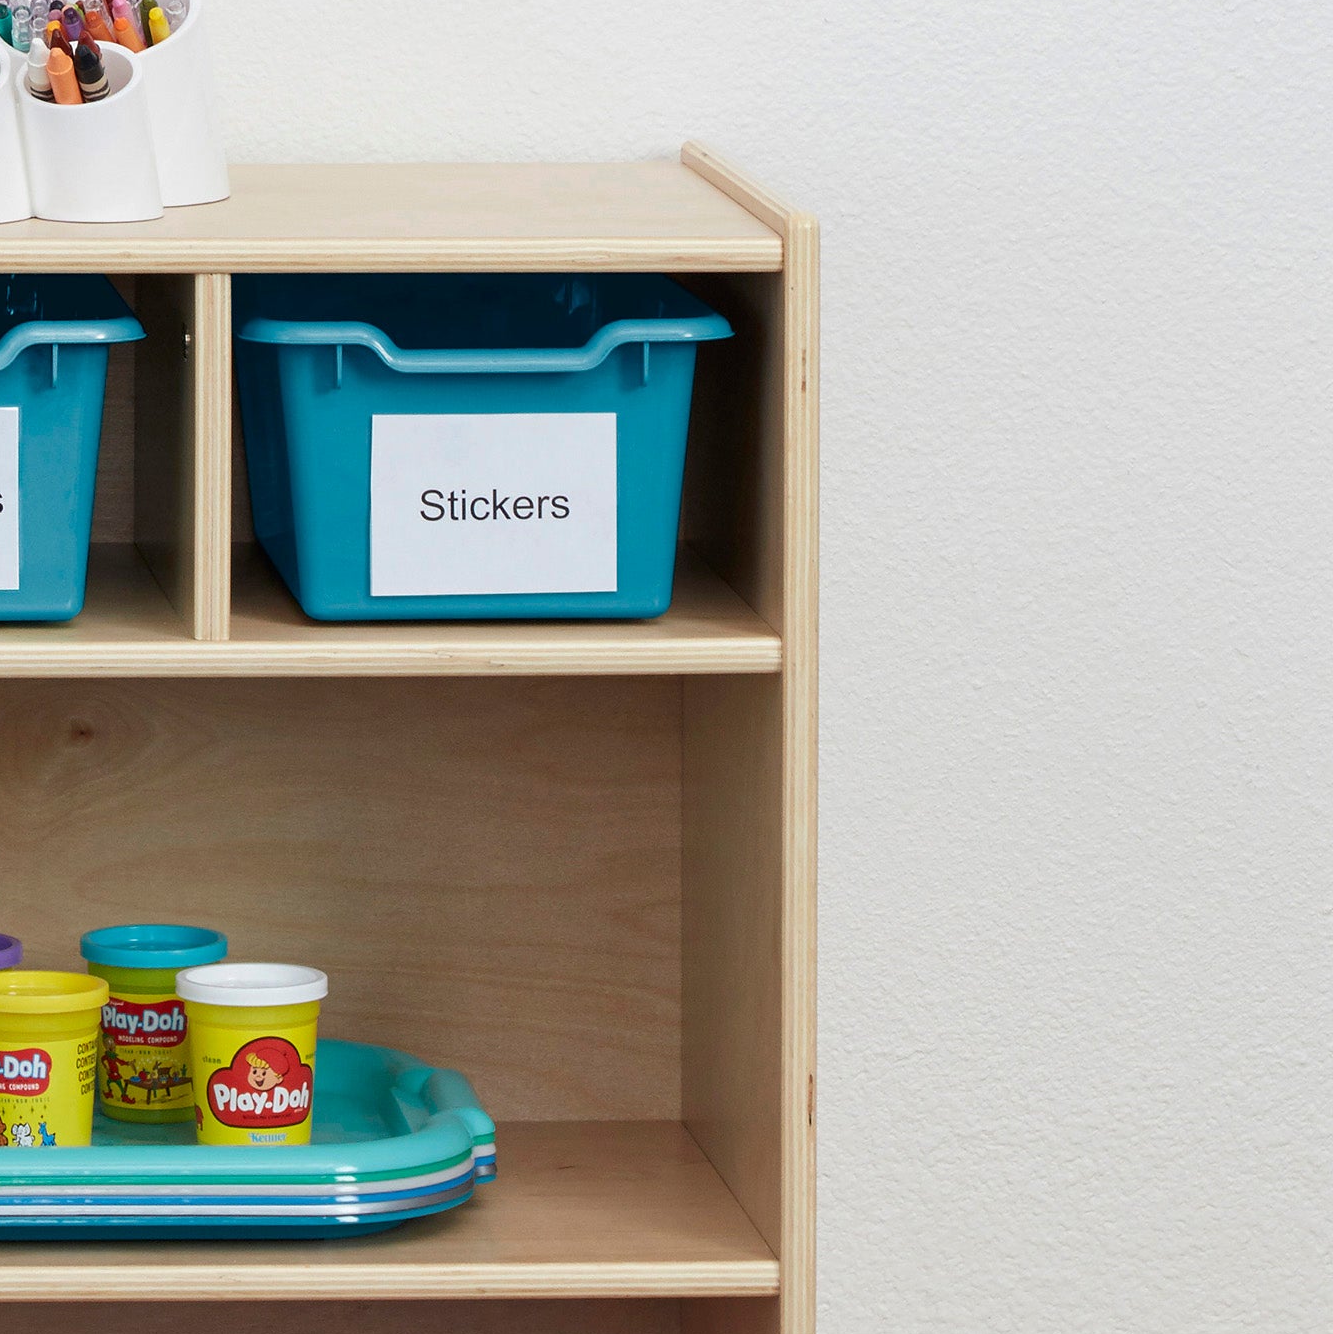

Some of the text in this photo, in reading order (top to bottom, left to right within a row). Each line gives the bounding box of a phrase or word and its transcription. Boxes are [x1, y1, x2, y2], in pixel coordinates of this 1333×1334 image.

[420, 488, 571, 522] Stickers
[101, 1004, 186, 1034] Play-Doh
[8, 1082, 40, 1091] COMPOUND
[213, 1081, 310, 1115] Play-Doh
